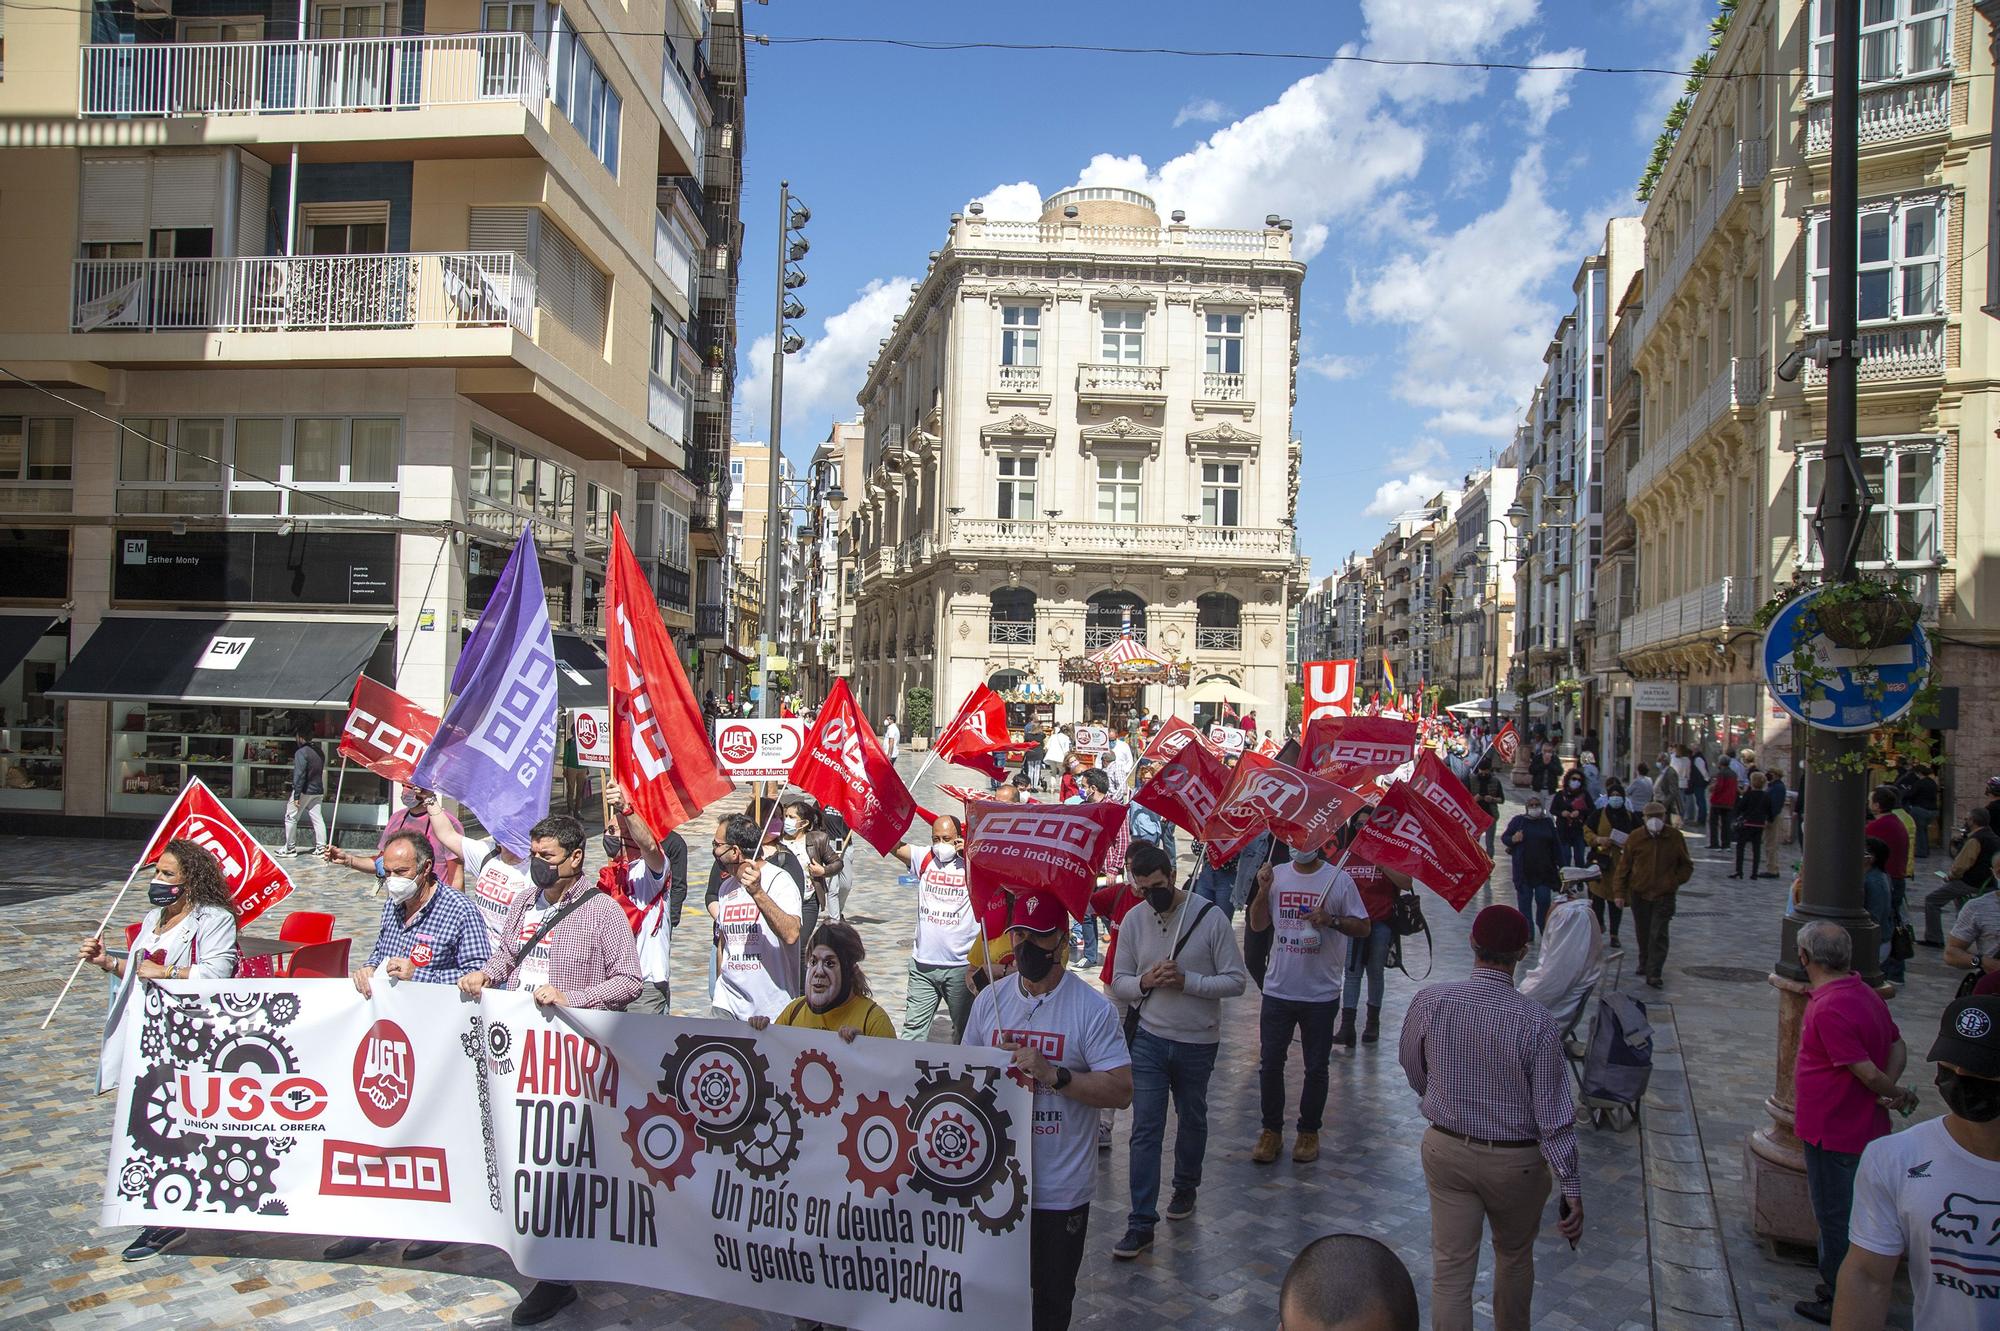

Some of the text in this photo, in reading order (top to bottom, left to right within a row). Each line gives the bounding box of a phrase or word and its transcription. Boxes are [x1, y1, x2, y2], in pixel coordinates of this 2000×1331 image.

[127, 542, 145, 553] EM
[147, 555, 200, 567] Esther Monty
[1100, 607, 1143, 616] CAJAMCIA
[210, 641, 246, 655] EM
[578, 718, 594, 732] UGT
[724, 731, 752, 746] UGT
[732, 768, 753, 777] Región
[765, 768, 789, 776] Murcia
[851, 779, 866, 794] de
[982, 815, 1094, 850] CCOO
[1363, 824, 1409, 850] federación
[1410, 843, 1423, 855] de
[1000, 845, 1021, 858] de
[1023, 847, 1088, 880] industria
[927, 871, 965, 887] CCOO
[725, 904, 757, 921] CCOO
[928, 915, 960, 927] Repsol
[727, 961, 762, 972] Repsol
[1966, 1015, 1977, 1029] B
[369, 1036, 409, 1081] UGT
[517, 1029, 620, 1109] AHORA
[183, 1118, 327, 1133] UNIÓN SINDICAL OBRERA
[515, 1098, 597, 1169] TOCA
[331, 1150, 443, 1192] CCOO
[513, 1168, 659, 1249] CUMPLIR
[711, 1168, 966, 1255] Un país en deuda con
[713, 1232, 964, 1314] su gente trabajadora
[1932, 1272, 2000, 1300] HON
